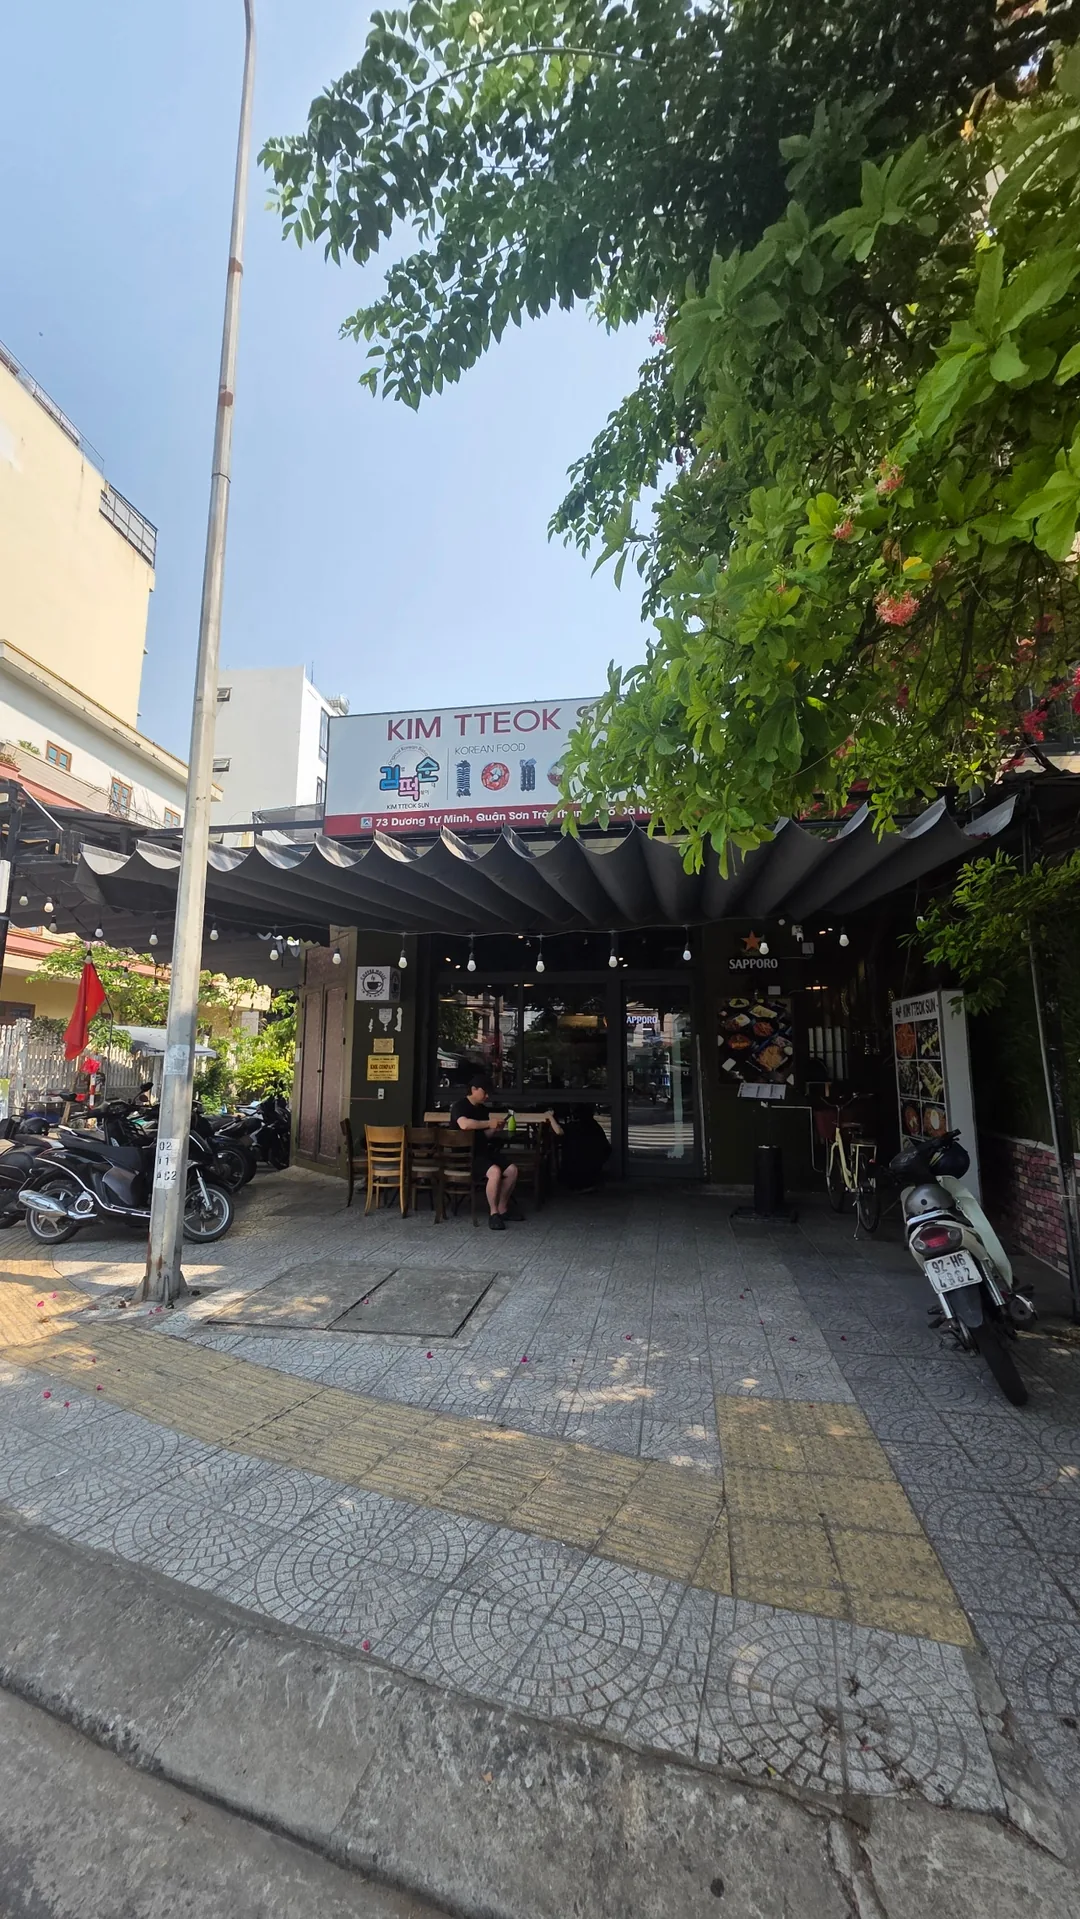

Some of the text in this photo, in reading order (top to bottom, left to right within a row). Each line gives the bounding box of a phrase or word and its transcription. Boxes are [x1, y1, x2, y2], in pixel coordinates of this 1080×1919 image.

[387, 716, 441, 741] KIM
[453, 708, 561, 736] TTEOK
[454, 743, 526, 756] KOREAN FOOD
[375, 818, 389, 827] 73
[391, 817, 426, 827] Dương
[428, 815, 442, 826] Tự
[443, 814, 473, 824] Minh,
[476, 812, 506, 823] Quận
[509, 811, 530, 820] Sơn
[729, 958, 778, 970] SAPPORO
[159, 1141, 172, 1151] 02
[931, 1253, 967, 1274] 92-H6
